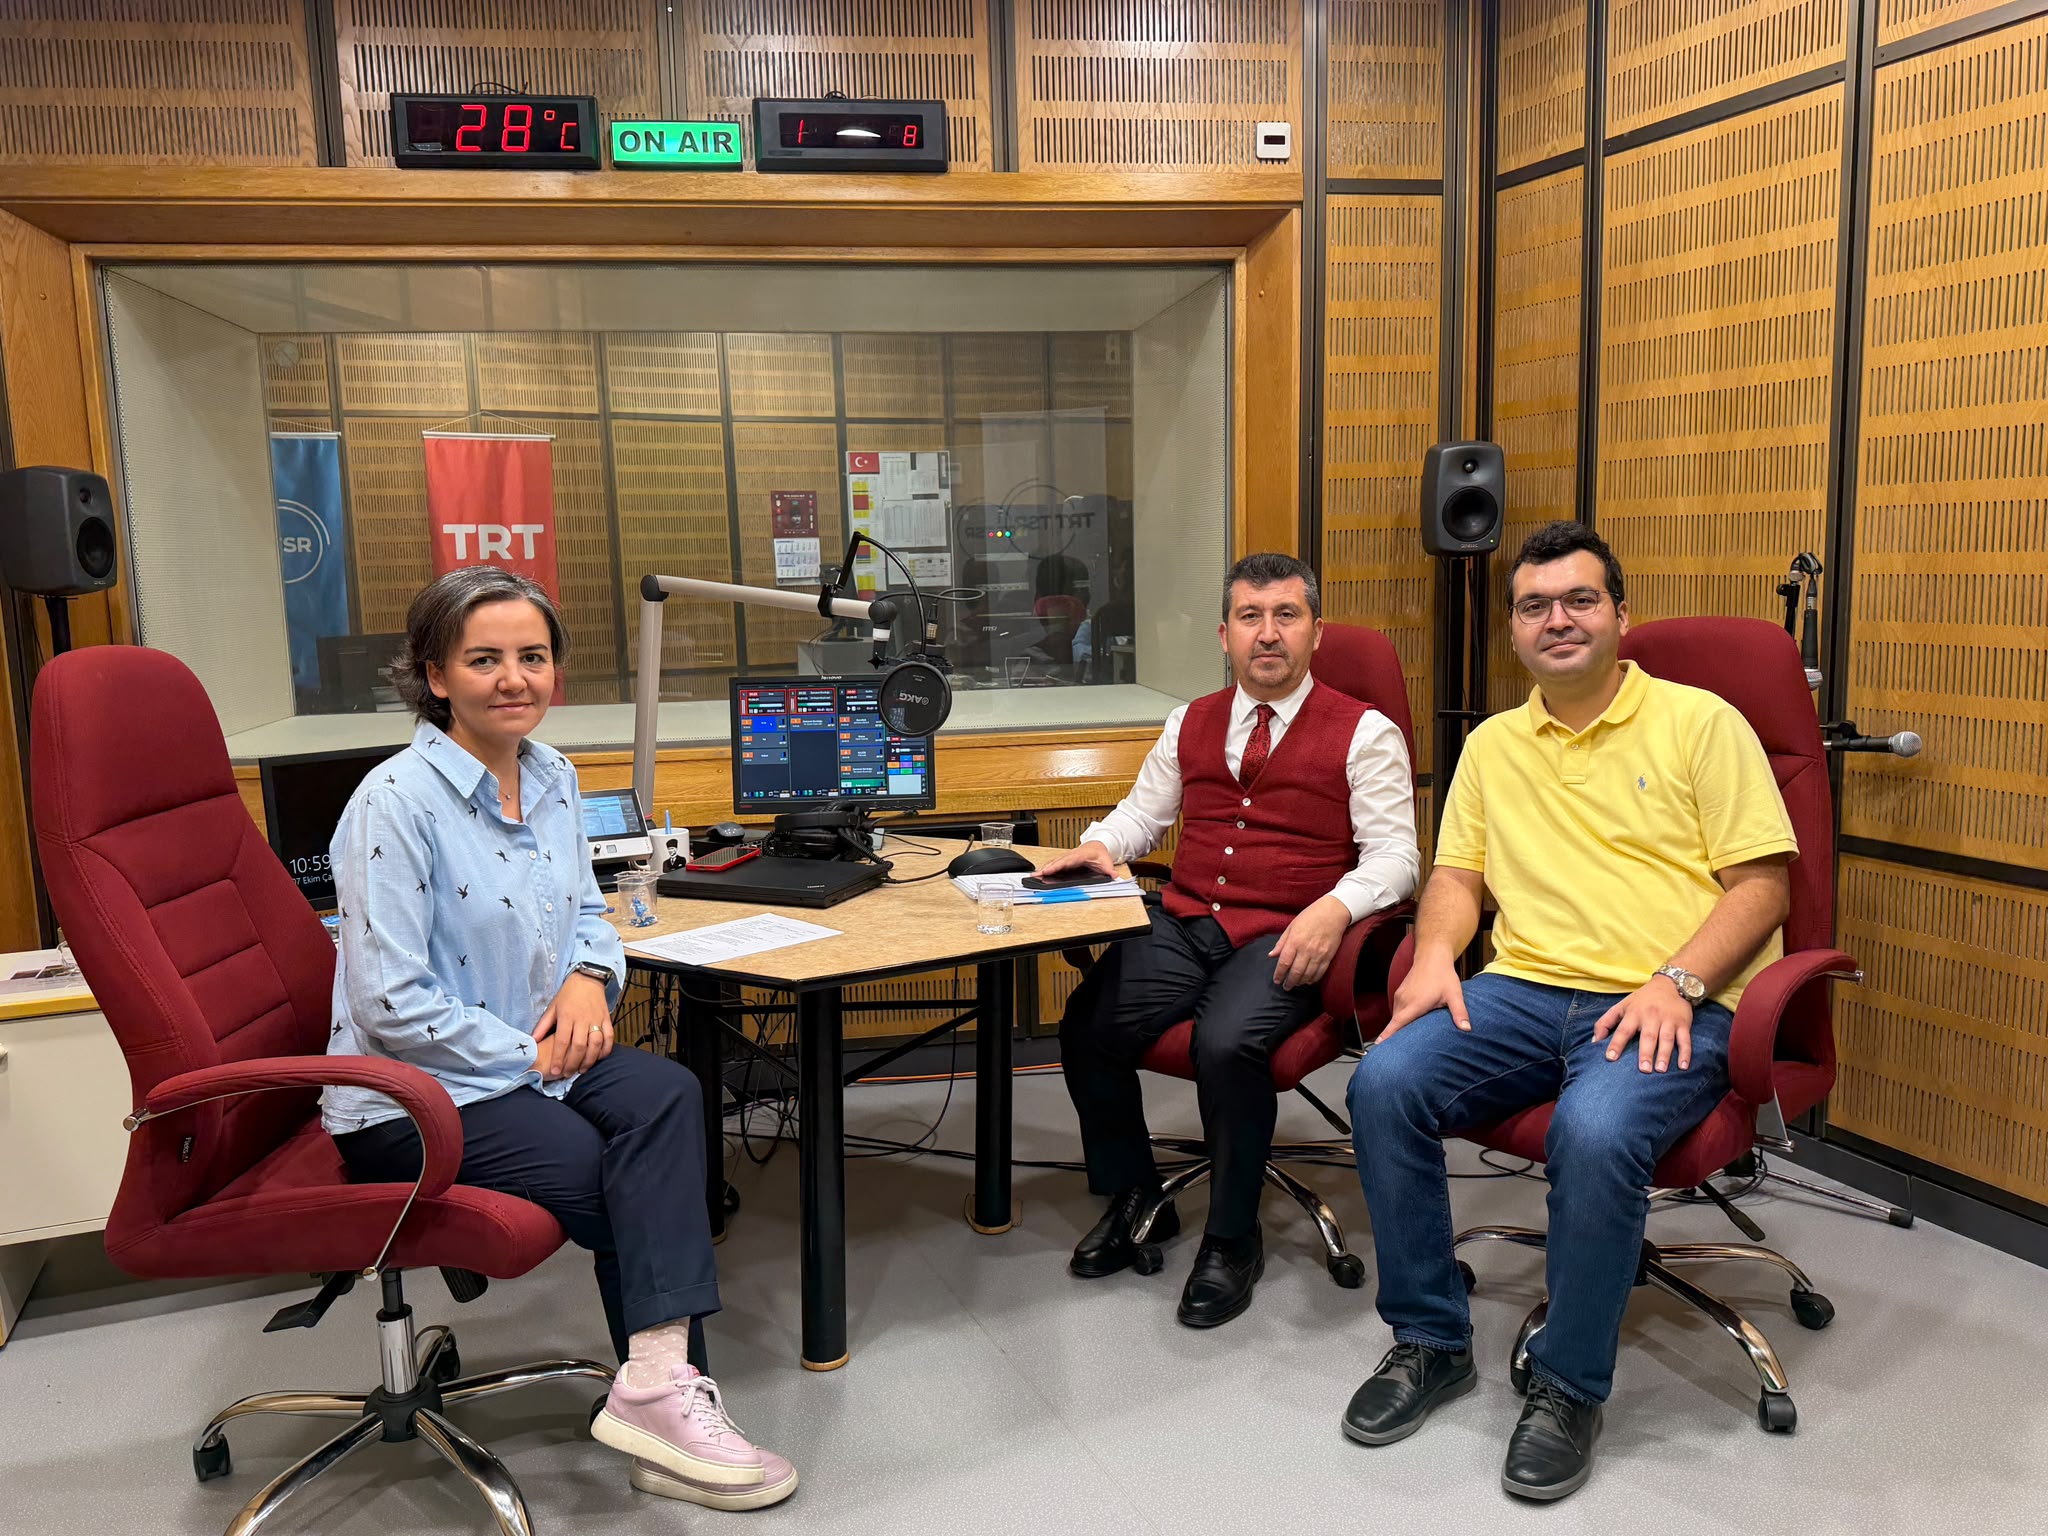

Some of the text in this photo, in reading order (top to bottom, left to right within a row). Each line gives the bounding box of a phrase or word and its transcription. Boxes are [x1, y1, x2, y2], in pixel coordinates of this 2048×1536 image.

[619, 130, 734, 153] ON AIR
[902, 125, 918, 147] 8
[279, 536, 312, 553] SR
[442, 524, 544, 560] TRT
[898, 692, 923, 704] AKG
[290, 854, 331, 874] 10:59
[303, 876, 320, 884] Ekim
